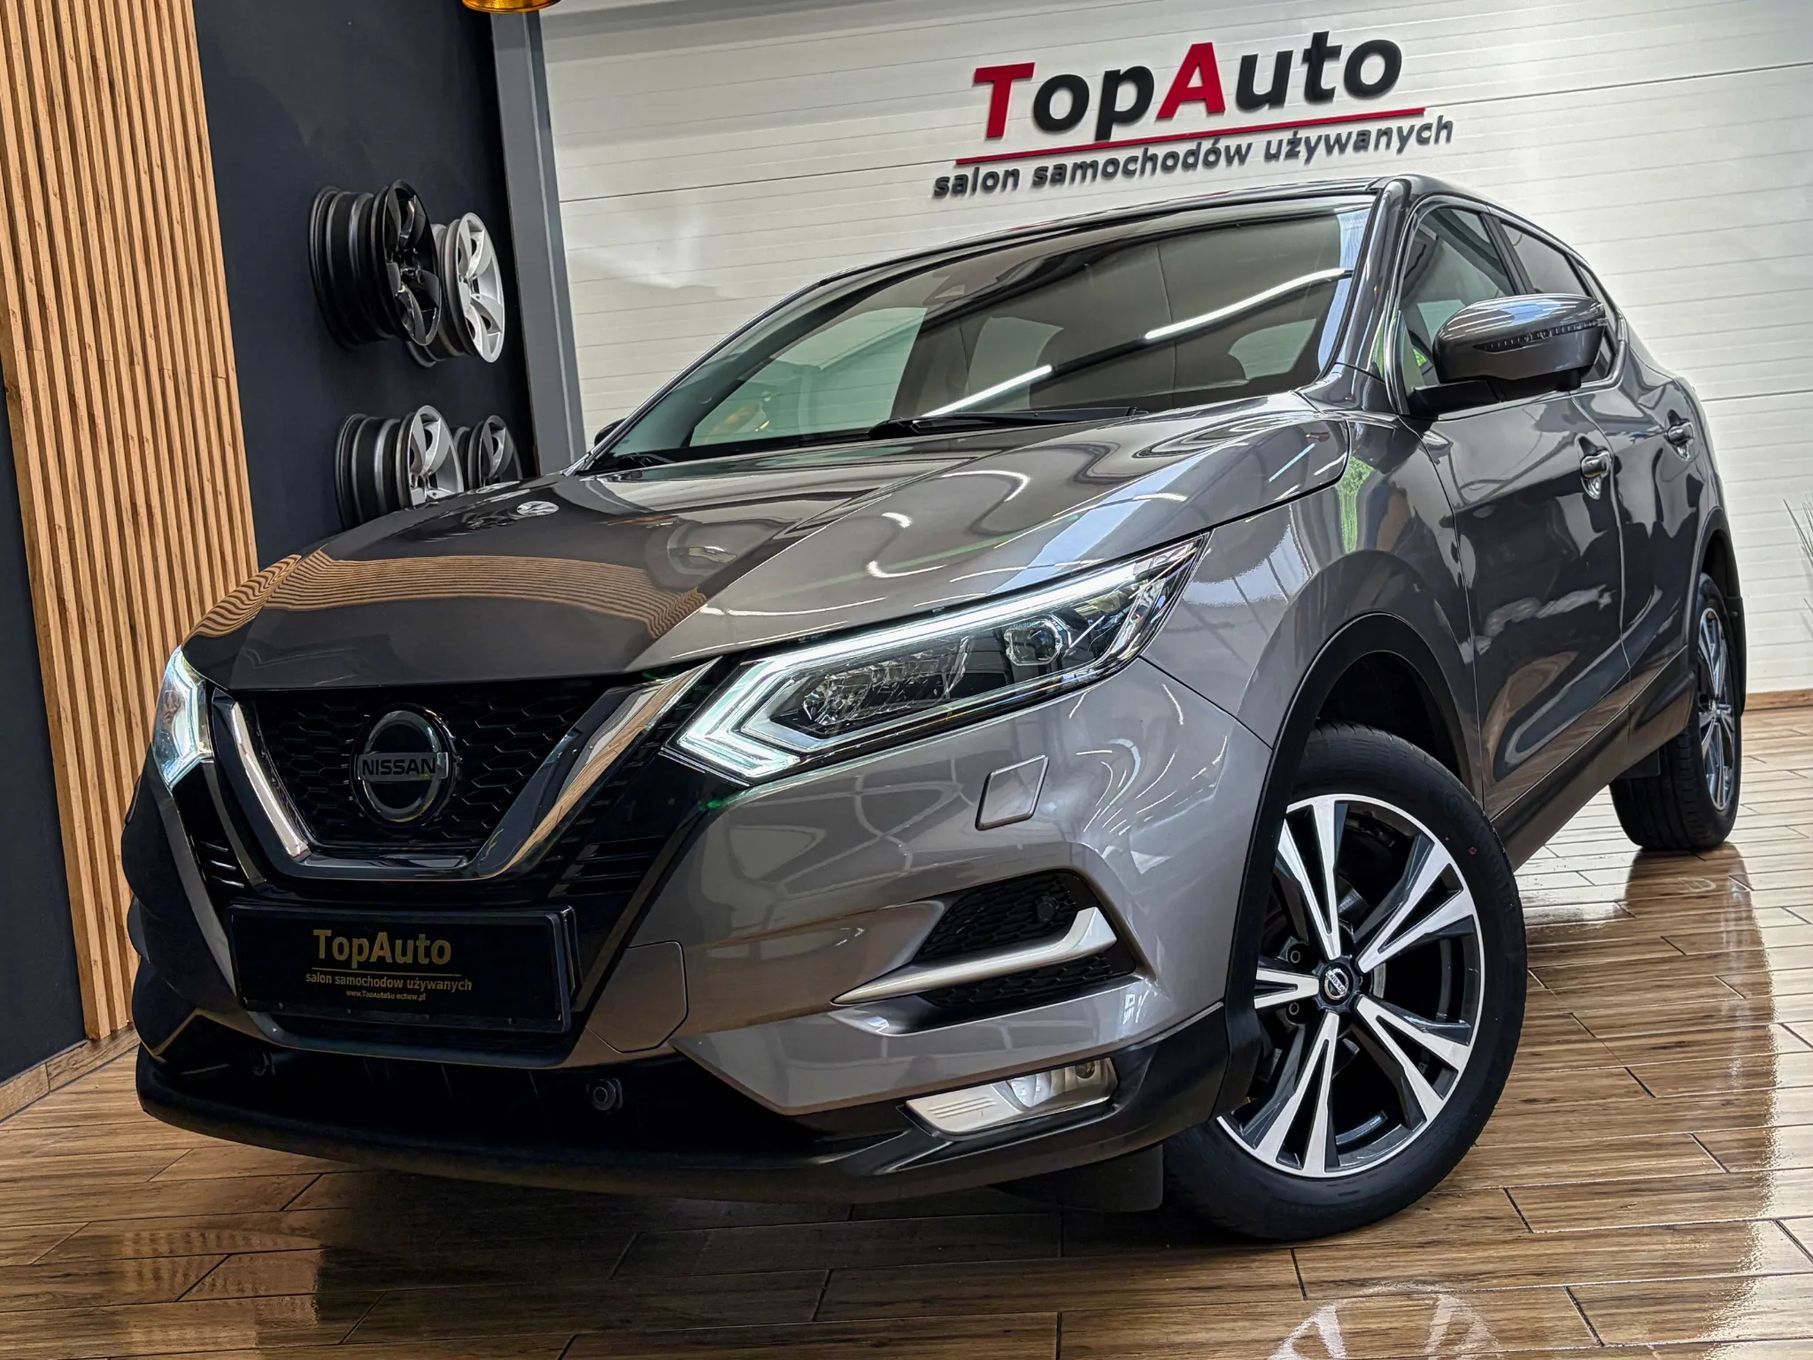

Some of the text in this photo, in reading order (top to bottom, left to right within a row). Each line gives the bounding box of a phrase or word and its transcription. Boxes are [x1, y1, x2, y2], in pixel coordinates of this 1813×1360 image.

[974, 31, 1403, 141] TopAuto
[933, 115, 1455, 198] salon samochodów używanych
[361, 759, 436, 775] NISSAN
[312, 928, 452, 969] TopAuto
[305, 971, 333, 985] salon
[406, 977, 473, 993] używanych
